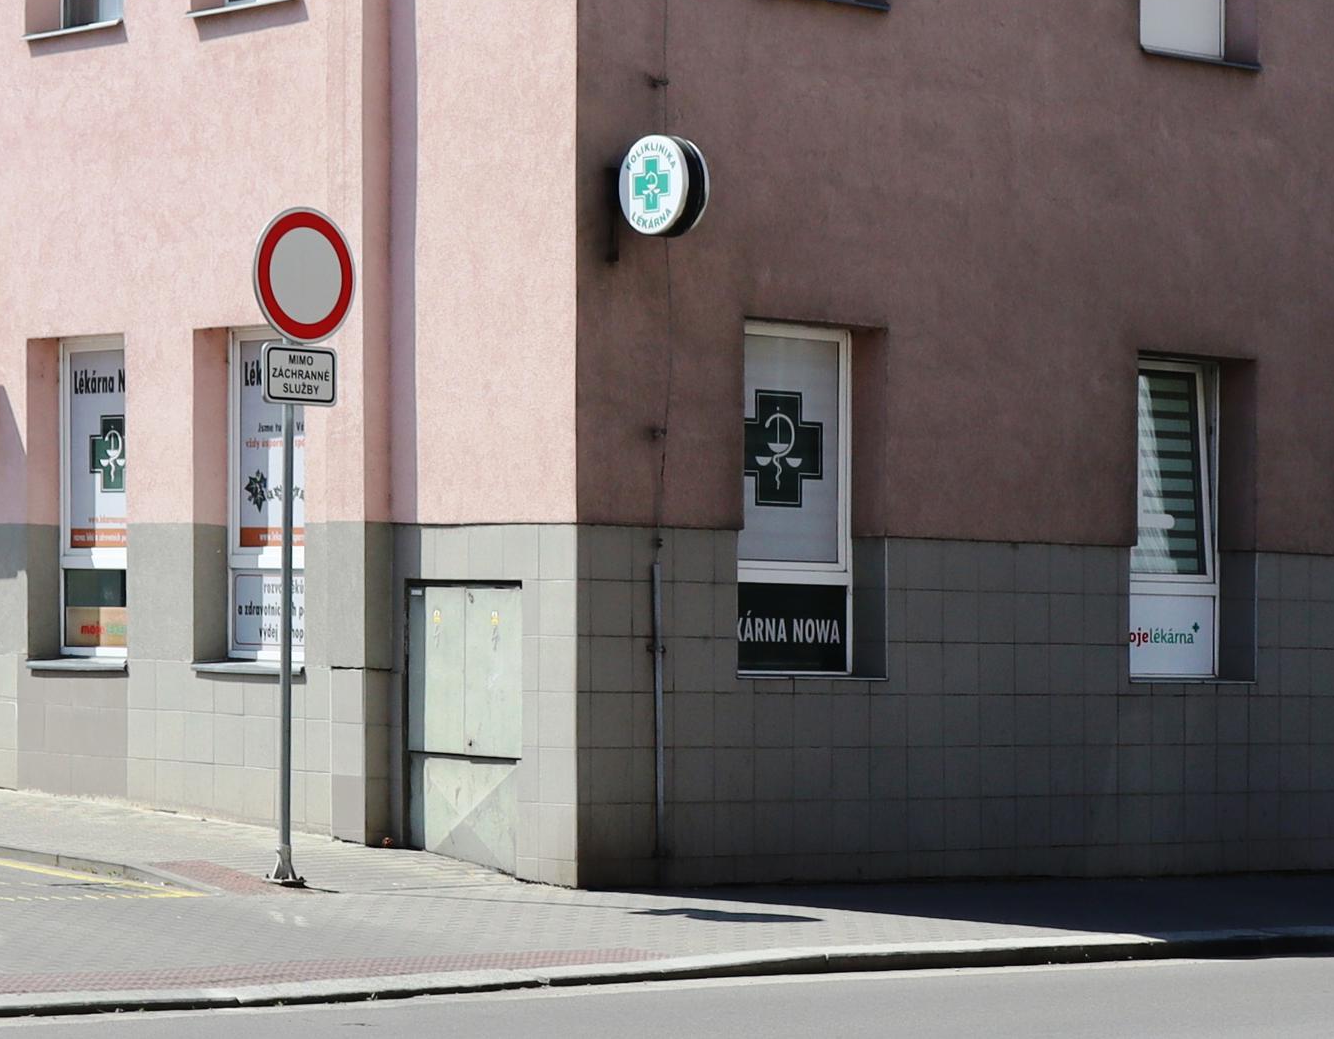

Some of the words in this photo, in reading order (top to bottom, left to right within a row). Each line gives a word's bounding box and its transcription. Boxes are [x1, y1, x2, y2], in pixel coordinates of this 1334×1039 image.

[626, 142, 676, 170] POLIKLINIKA
[288, 354, 314, 366] MIMO
[74, 369, 114, 394] Lékárna
[272, 366, 330, 382] ZÁCHRANNÉ
[283, 383, 320, 395] SLUŽBY
[793, 618, 840, 644] NOWA
